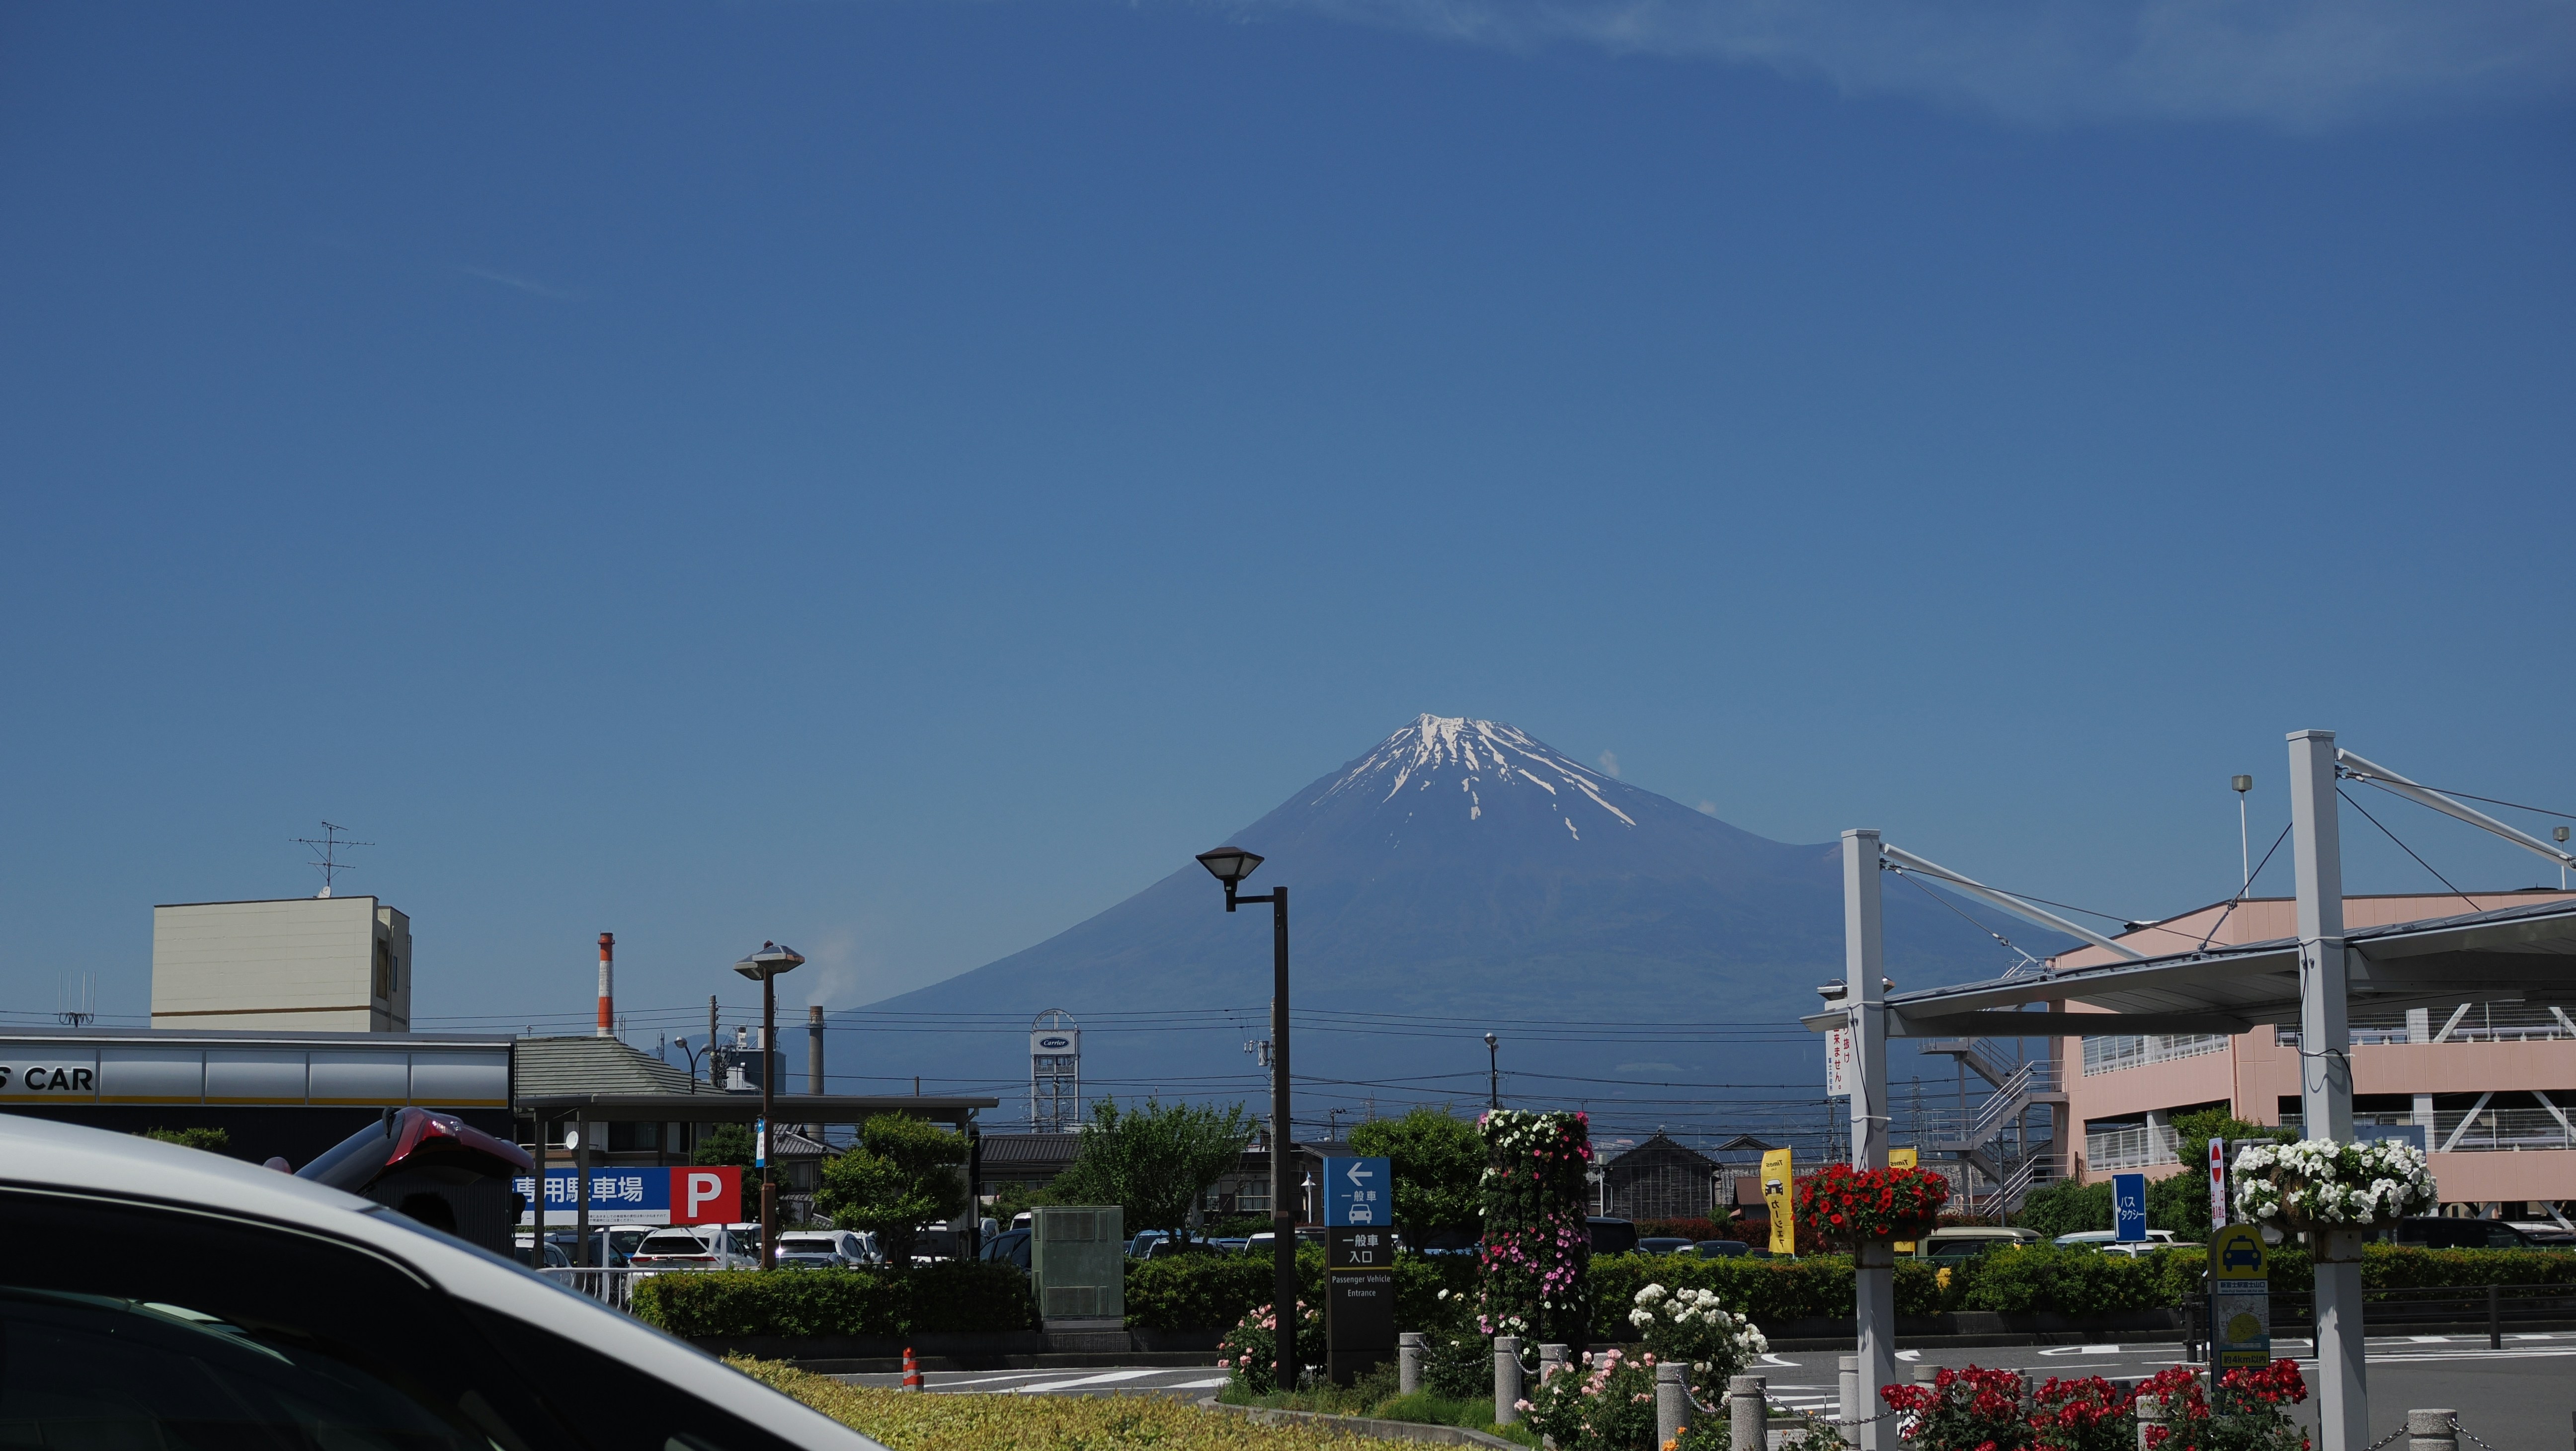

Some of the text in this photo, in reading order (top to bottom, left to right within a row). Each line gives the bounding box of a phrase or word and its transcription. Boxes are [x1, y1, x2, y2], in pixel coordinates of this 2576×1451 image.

[24, 1067, 93, 1091] CAR
[512, 1176, 644, 1203] 専用駐車場
[688, 1173, 722, 1217] P
[1341, 1190, 1377, 1202] 一般車
[2120, 1196, 2135, 1208] バス
[2121, 1209, 2144, 1220] タクシー
[1342, 1234, 1379, 1247] 一般車
[1349, 1250, 1372, 1263] 入口
[1332, 1276, 1366, 1285] Passenger
[2224, 1355, 2266, 1364] 約4km以内
